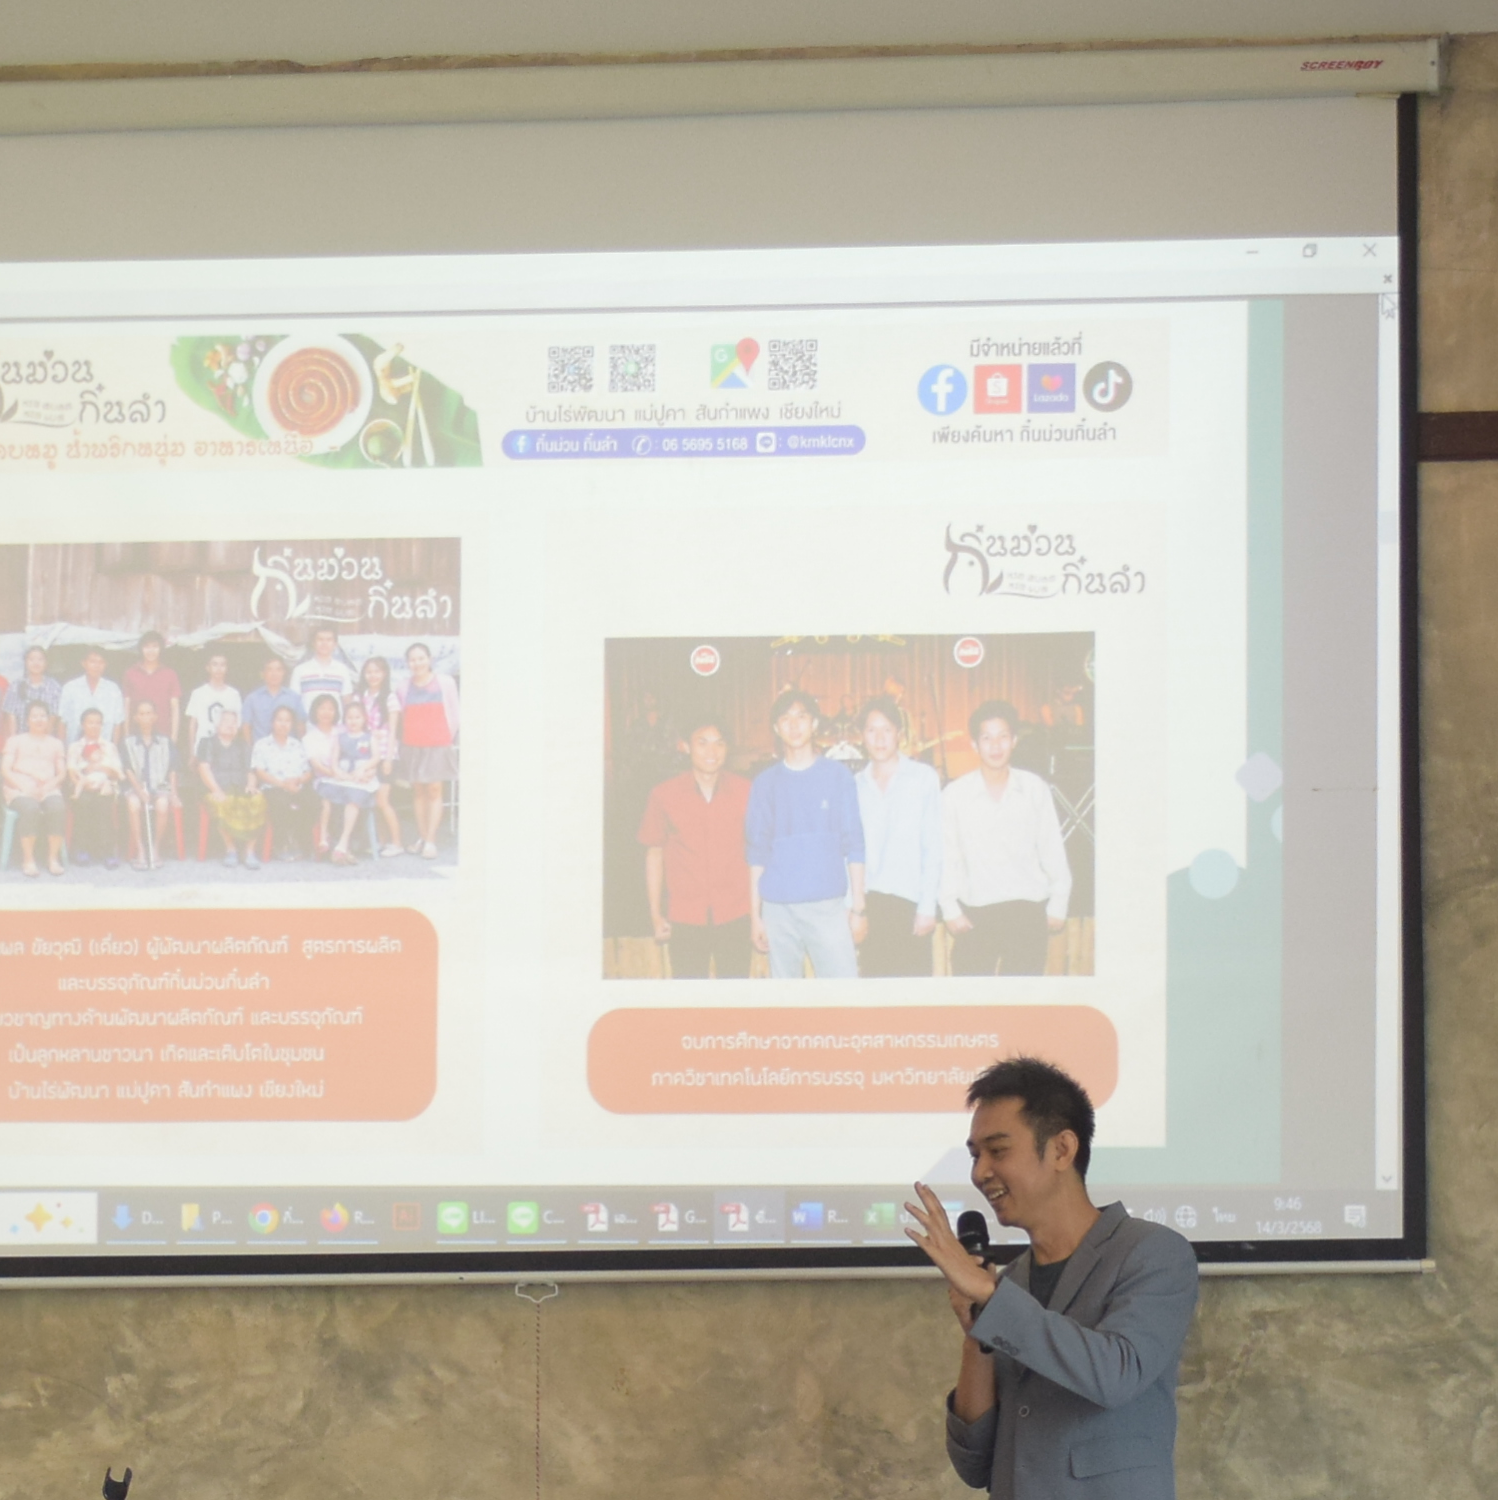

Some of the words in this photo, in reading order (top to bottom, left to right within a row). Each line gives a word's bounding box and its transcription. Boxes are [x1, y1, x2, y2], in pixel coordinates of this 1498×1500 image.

[969, 332, 1083, 358] มีจำหน่ายแล้วที่
[1033, 392, 1069, 402] Lazada
[634, 403, 686, 426] แม่ปูคา
[695, 402, 770, 421] สันกำแพง
[779, 400, 842, 420] เชียงใหม่
[662, 437, 678, 451] 06
[682, 437, 714, 451] 5695
[717, 436, 748, 451] 5168
[932, 425, 1014, 444] เพียงค้นหา
[301, 934, 402, 960] สูตรการผลิต
[251, 1006, 364, 1031] และบรรจุภัณฑ์
[681, 1031, 1000, 1053] จบการศึกษาจากคณะอุตสาหกรรมเกษตร
[8, 1042, 153, 1068] เป็นลูกหลานชาวนา
[651, 1066, 865, 1090] ภาควิชาเทคโนโลยีการบรรจุ
[117, 1079, 170, 1104] แม่ปูคา
[177, 1078, 252, 1099] สันกำแพง
[259, 1078, 324, 1099] เชียงใหม่
[1274, 1197, 1302, 1211] 9:46
[1256, 1220, 1322, 1235] 14/3/2568
